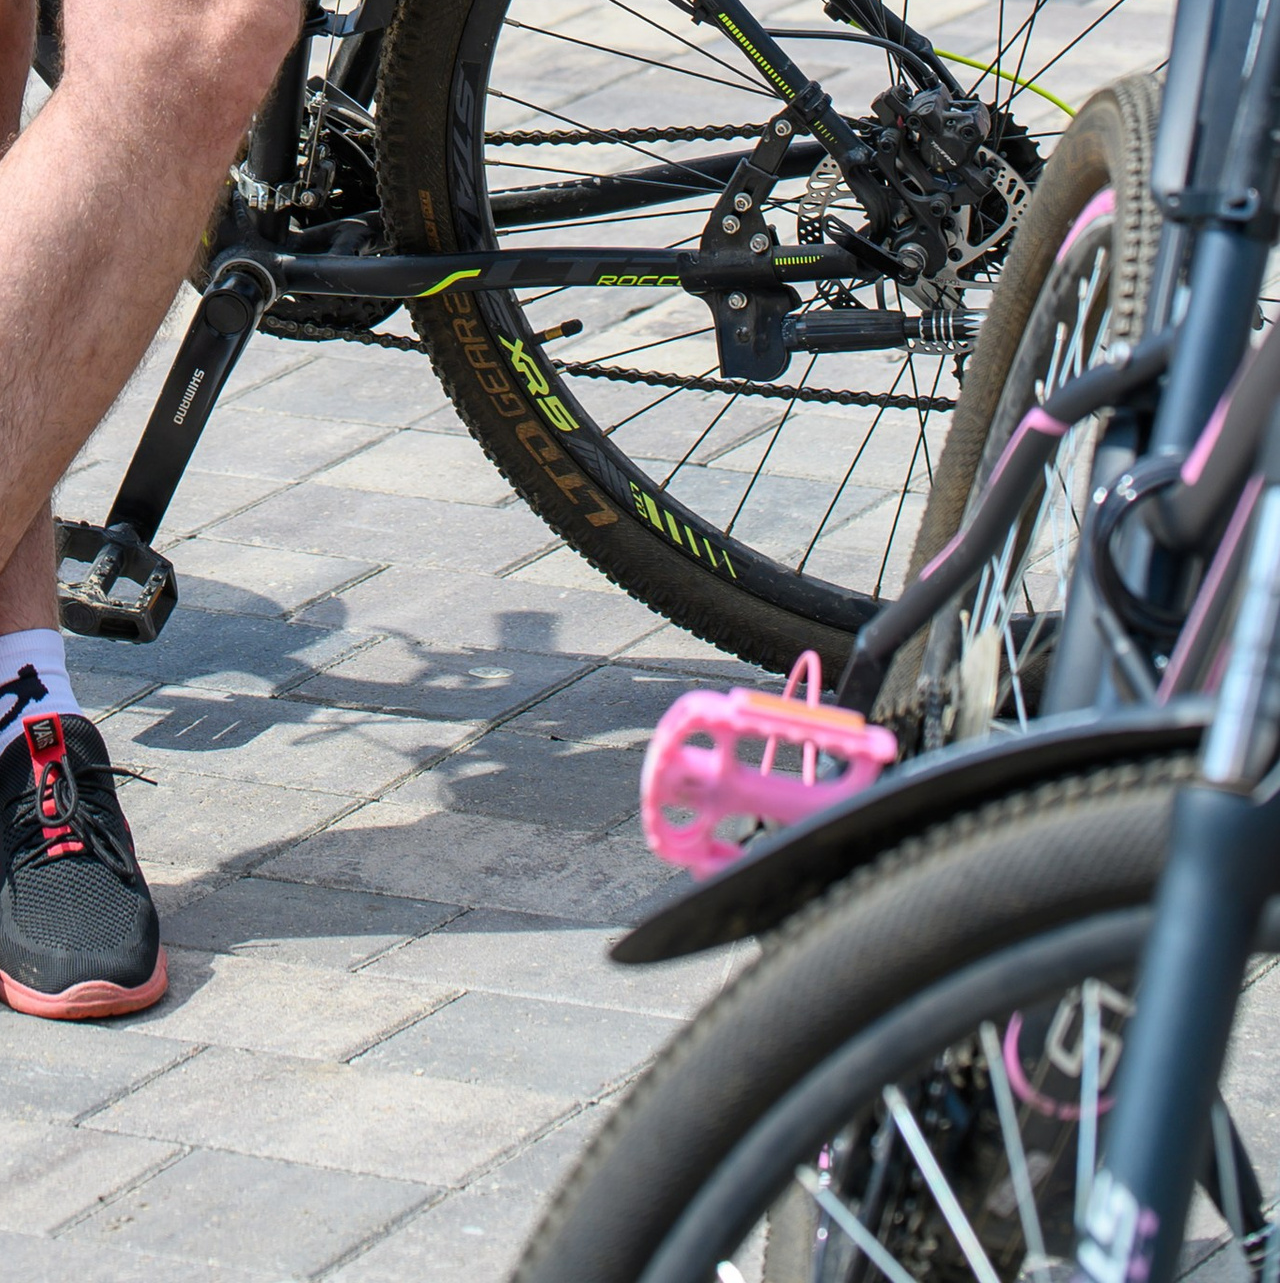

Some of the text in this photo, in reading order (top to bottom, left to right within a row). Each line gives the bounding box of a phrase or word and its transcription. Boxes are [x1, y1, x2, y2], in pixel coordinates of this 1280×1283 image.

[597, 275, 683, 286] ROCC
[173, 368, 205, 425] SHIMANO
[498, 335, 580, 431] XR5
